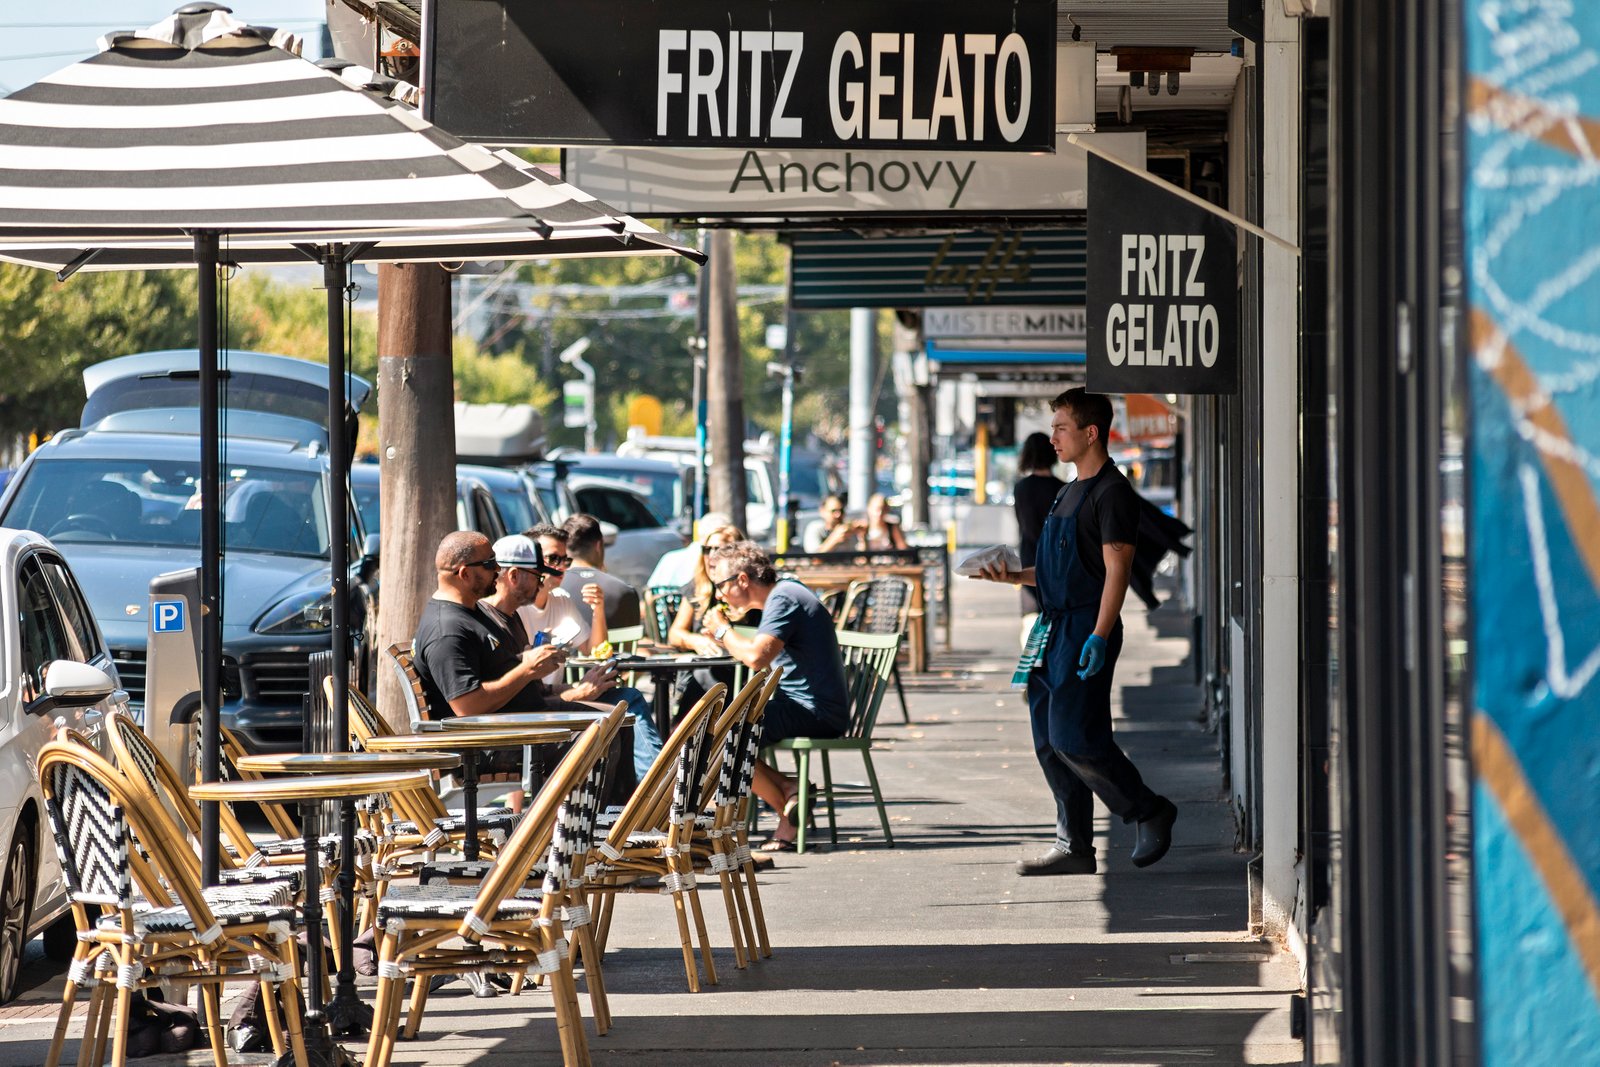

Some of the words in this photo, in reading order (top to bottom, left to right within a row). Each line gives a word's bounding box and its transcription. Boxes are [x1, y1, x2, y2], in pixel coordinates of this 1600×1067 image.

[656, 29, 804, 138] FRITZ
[828, 30, 1032, 142] GELATO
[729, 150, 977, 209] Anchovy
[1120, 233, 1206, 297] FRITZ
[1105, 303, 1220, 368] GELATO
[159, 605, 178, 629] P
